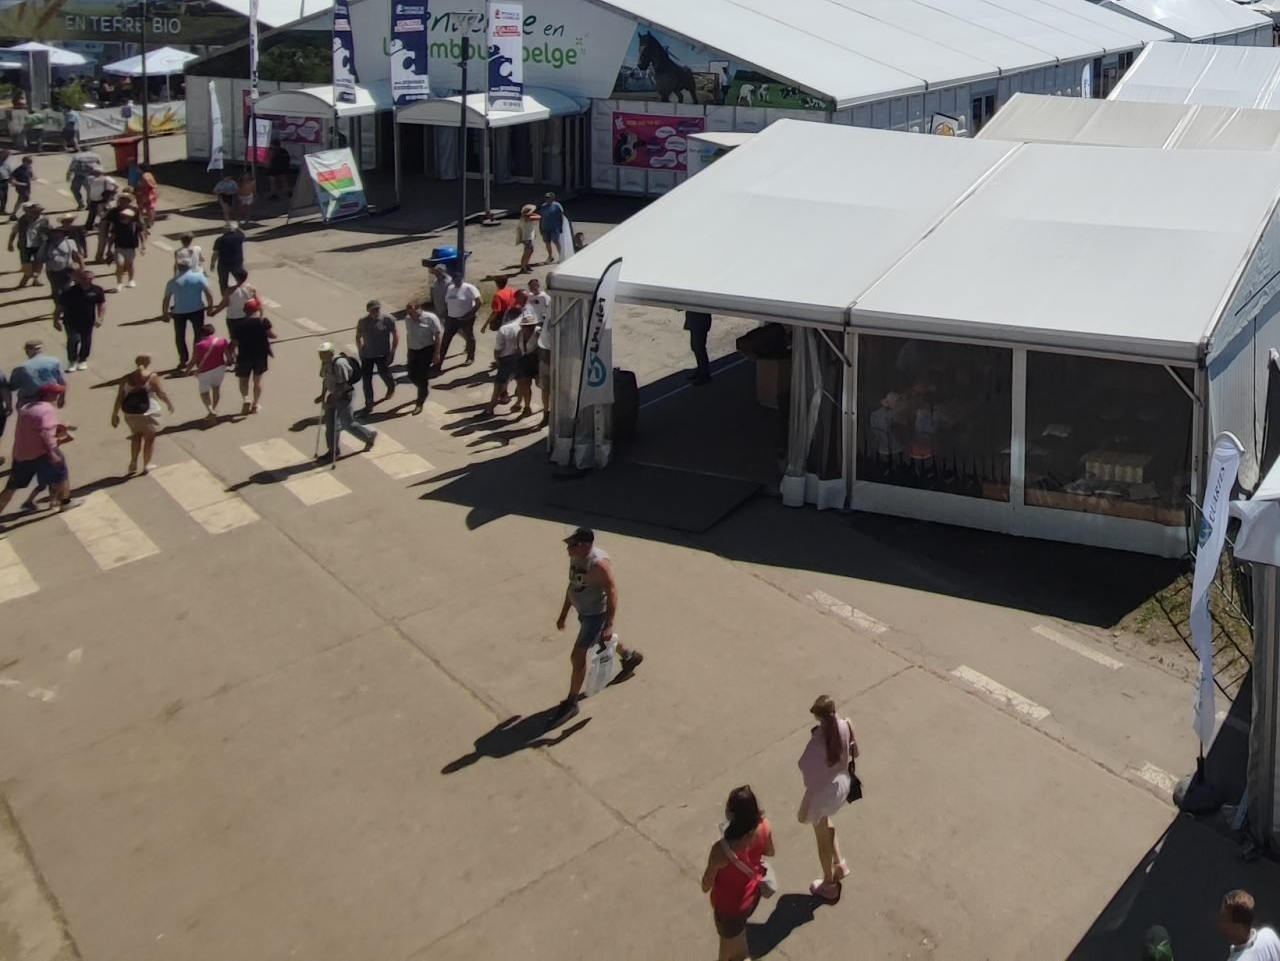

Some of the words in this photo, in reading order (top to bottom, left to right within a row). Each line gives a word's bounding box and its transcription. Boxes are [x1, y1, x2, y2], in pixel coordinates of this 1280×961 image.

[65, 15, 86, 31] EN
[91, 16, 143, 34] TERRE
[153, 17, 181, 34] BIO
[543, 22, 565, 37] en
